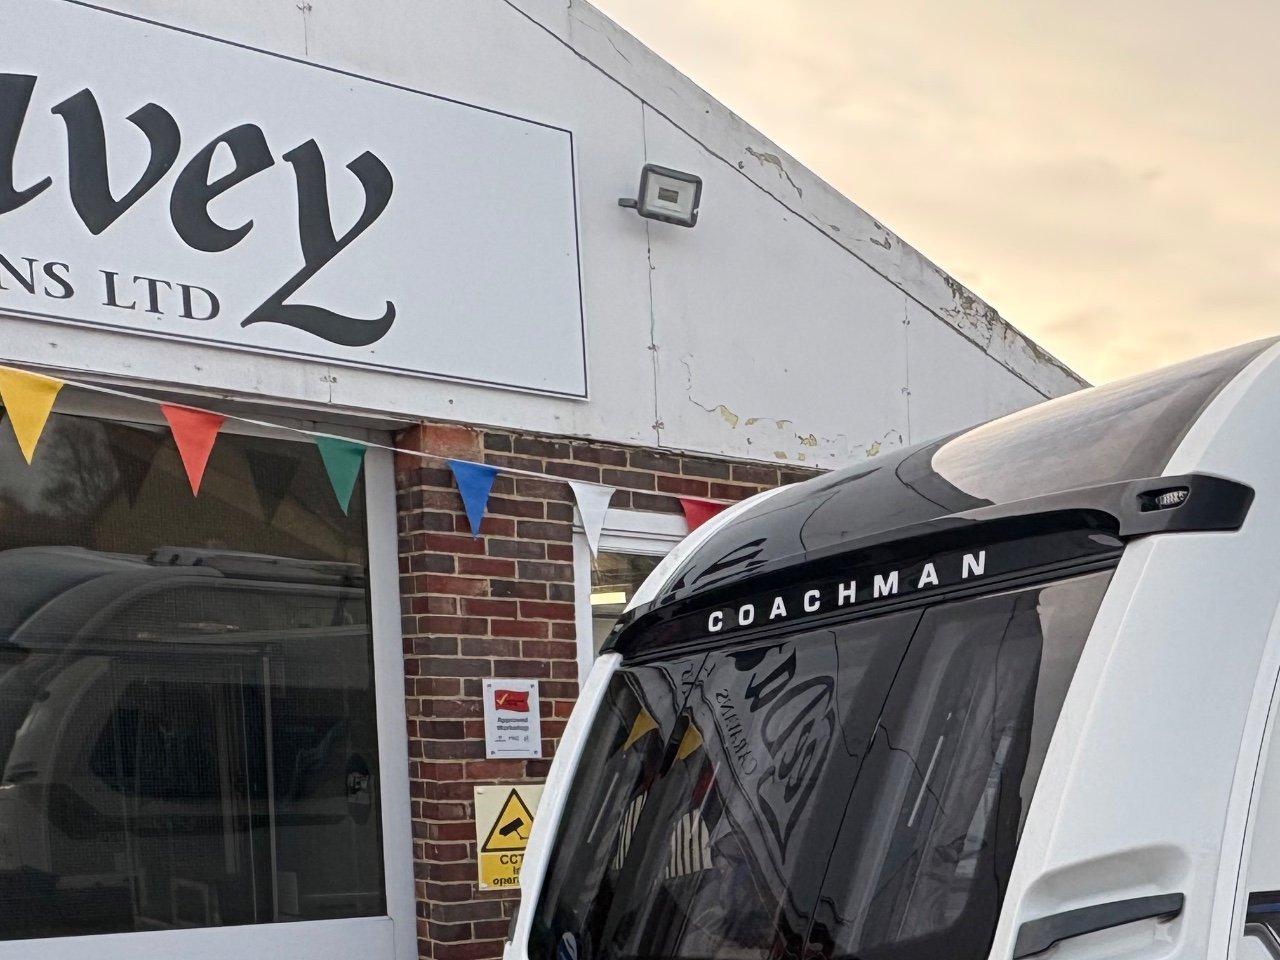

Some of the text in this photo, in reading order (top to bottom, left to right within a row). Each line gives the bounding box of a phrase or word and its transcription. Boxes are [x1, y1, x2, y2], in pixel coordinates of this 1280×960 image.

[0, 254, 220, 321] NS LTD
[708, 550, 986, 632] COACHMAN
